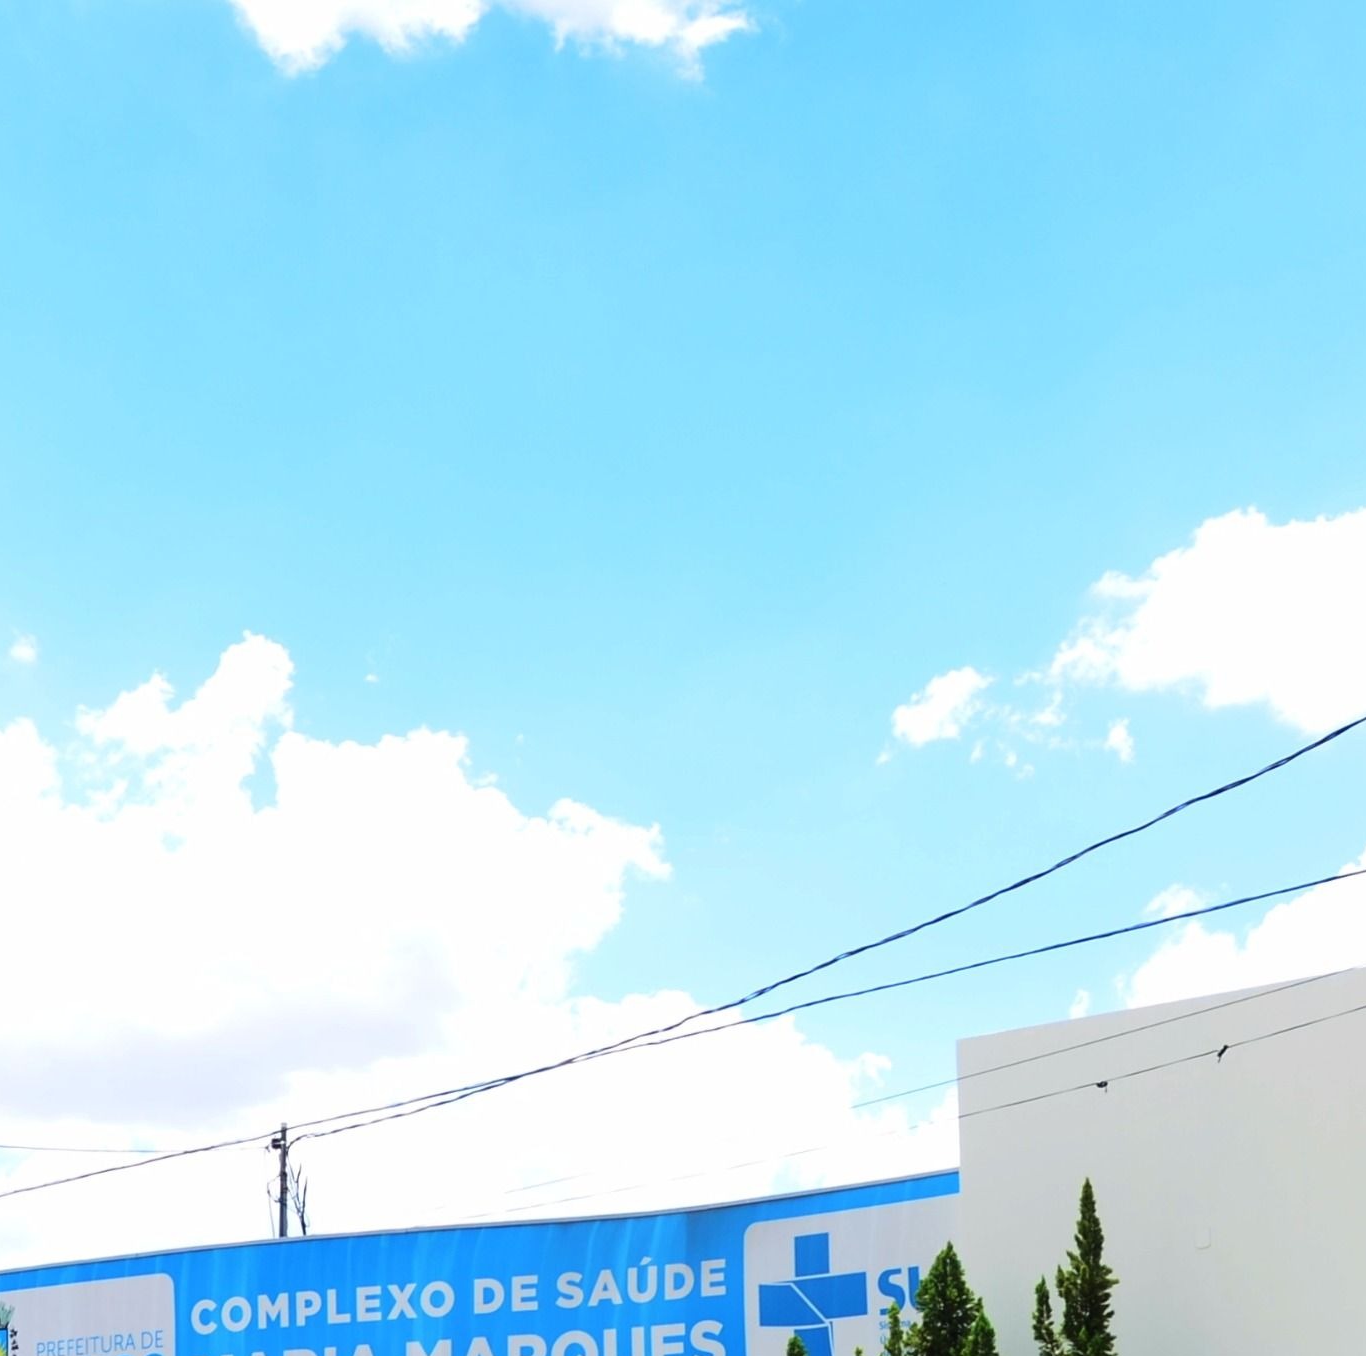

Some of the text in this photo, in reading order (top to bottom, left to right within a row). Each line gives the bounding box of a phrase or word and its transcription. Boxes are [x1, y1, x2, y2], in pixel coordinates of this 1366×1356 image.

[191, 1257, 727, 1335] COMPLEXO DE SAÚDE
[141, 1330, 164, 1349] DE
